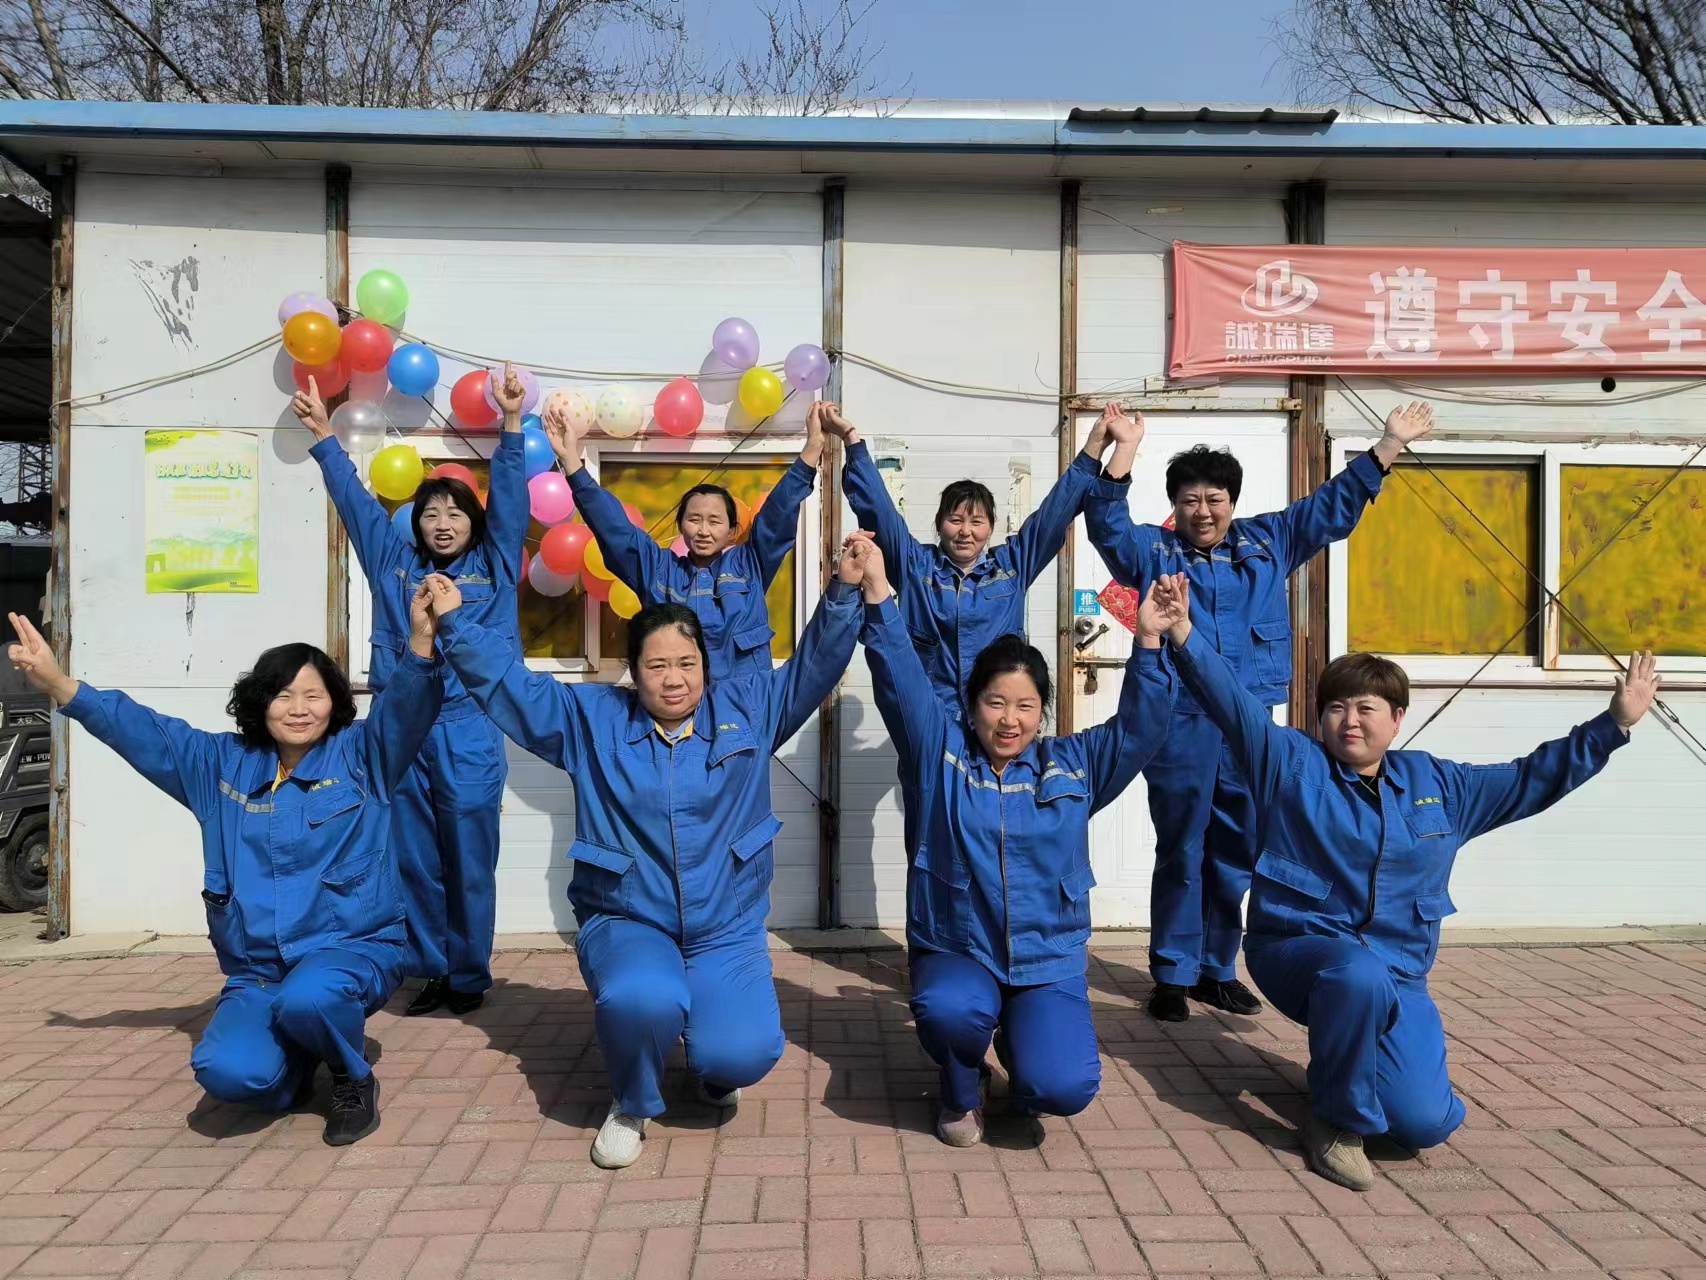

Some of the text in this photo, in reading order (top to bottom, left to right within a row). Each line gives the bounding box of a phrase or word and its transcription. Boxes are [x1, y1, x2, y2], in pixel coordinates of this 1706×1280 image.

[1365, 265, 1706, 362] 遵守安全
[1081, 593, 1095, 605] 推
